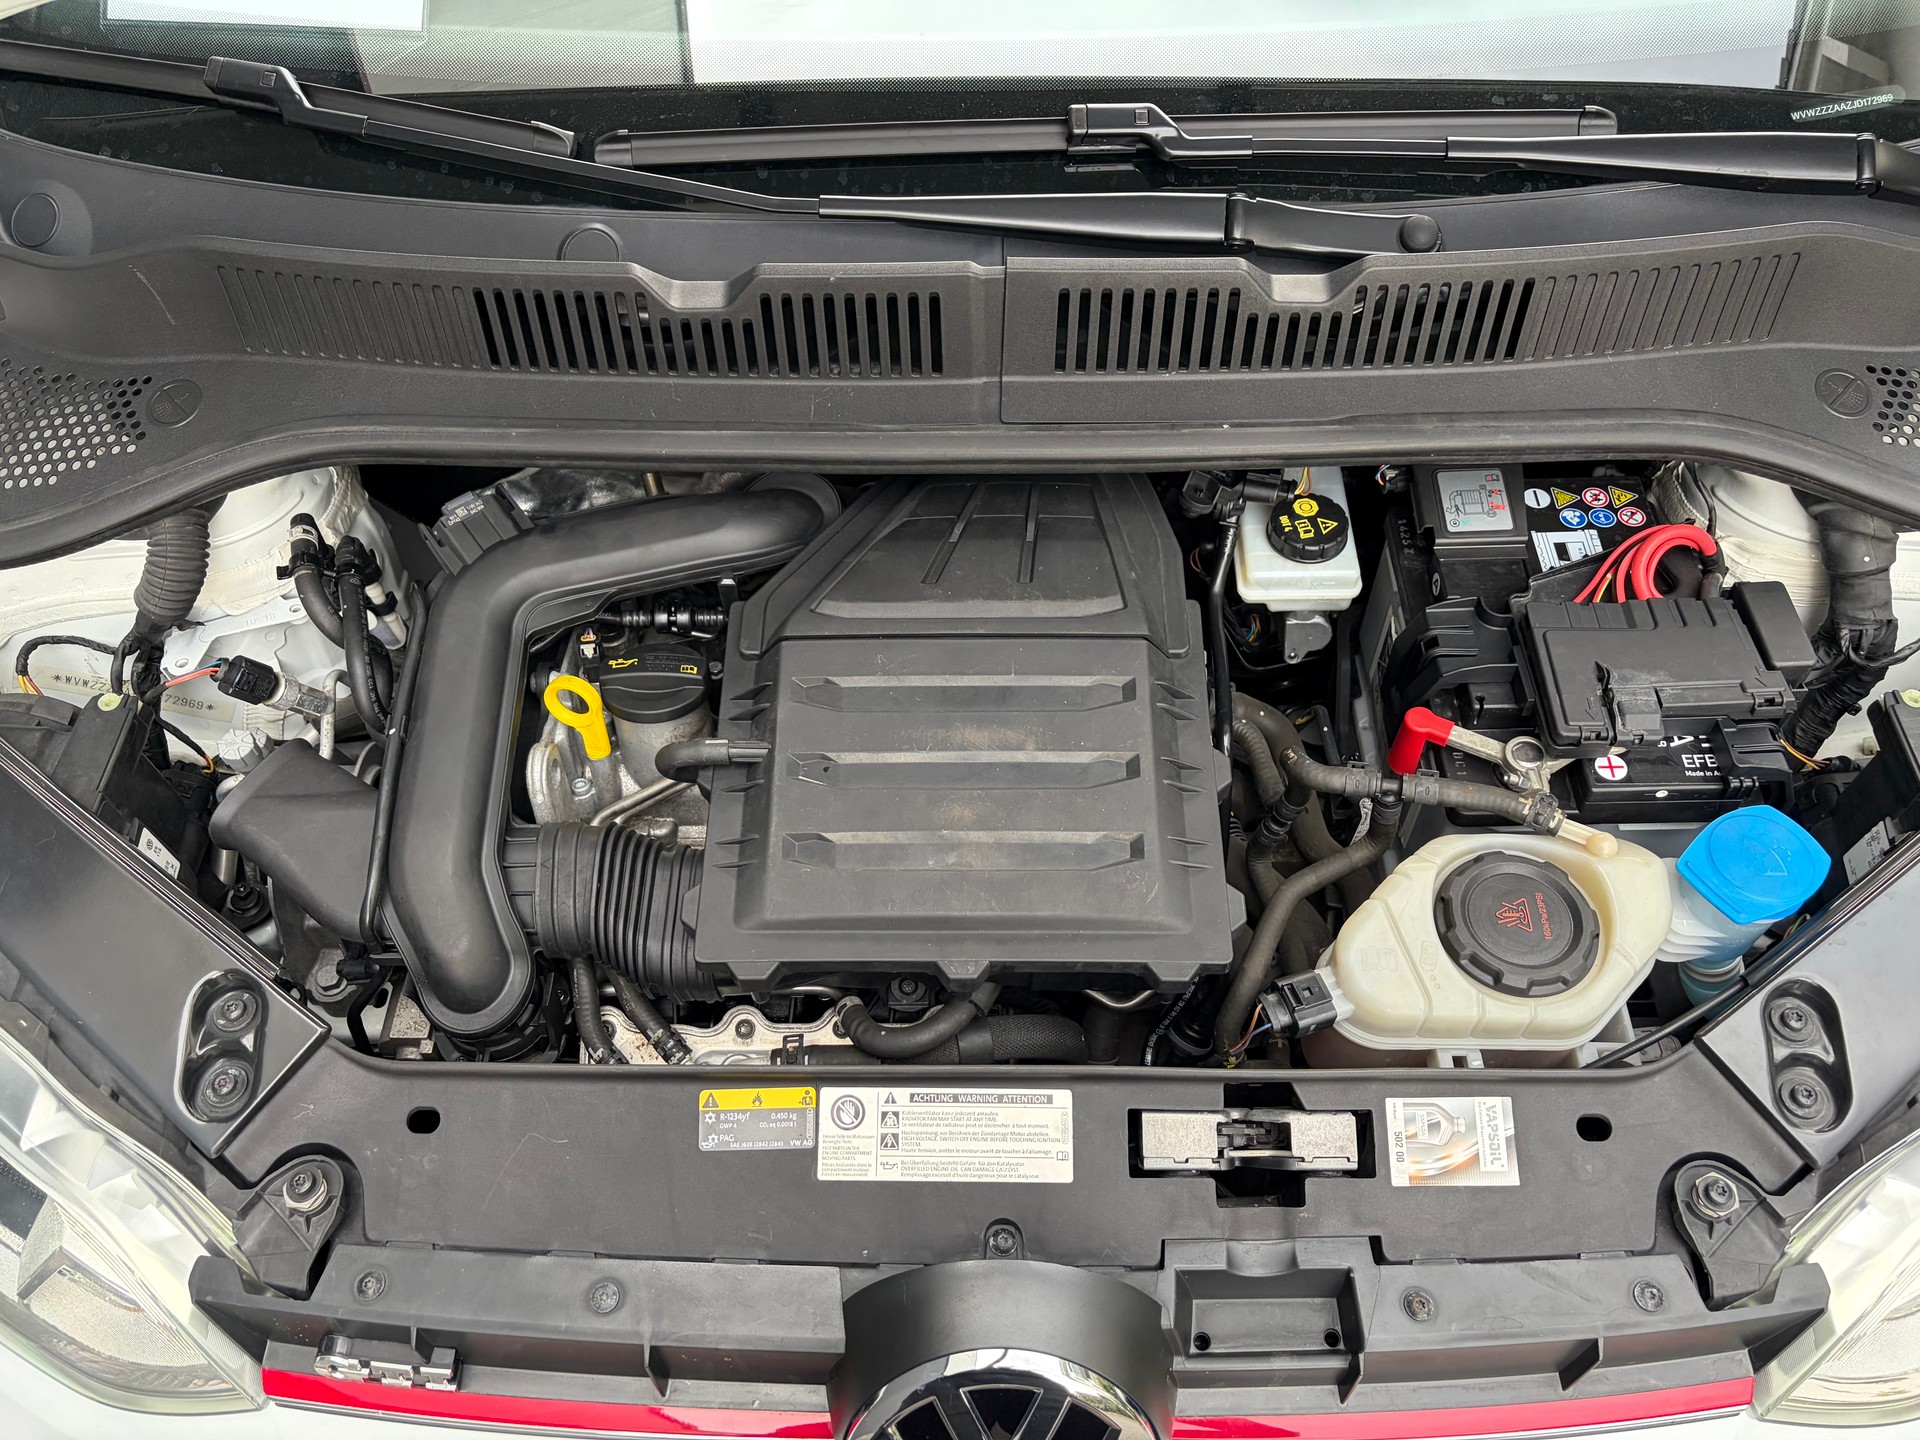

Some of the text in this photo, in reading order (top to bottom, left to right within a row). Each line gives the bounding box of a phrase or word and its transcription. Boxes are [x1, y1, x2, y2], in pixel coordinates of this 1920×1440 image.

[1790, 94, 1893, 120] WVWZZZAAZJD172969
[1279, 515, 1291, 526] DOT
[1681, 754, 1718, 768] EFB
[913, 1094, 1047, 1104] ACHTUNG WARNING ATTENTION
[720, 1112, 750, 1122] R-1234yf
[789, 1112, 797, 1120] kg
[1394, 1132, 1404, 1162] 502 00
